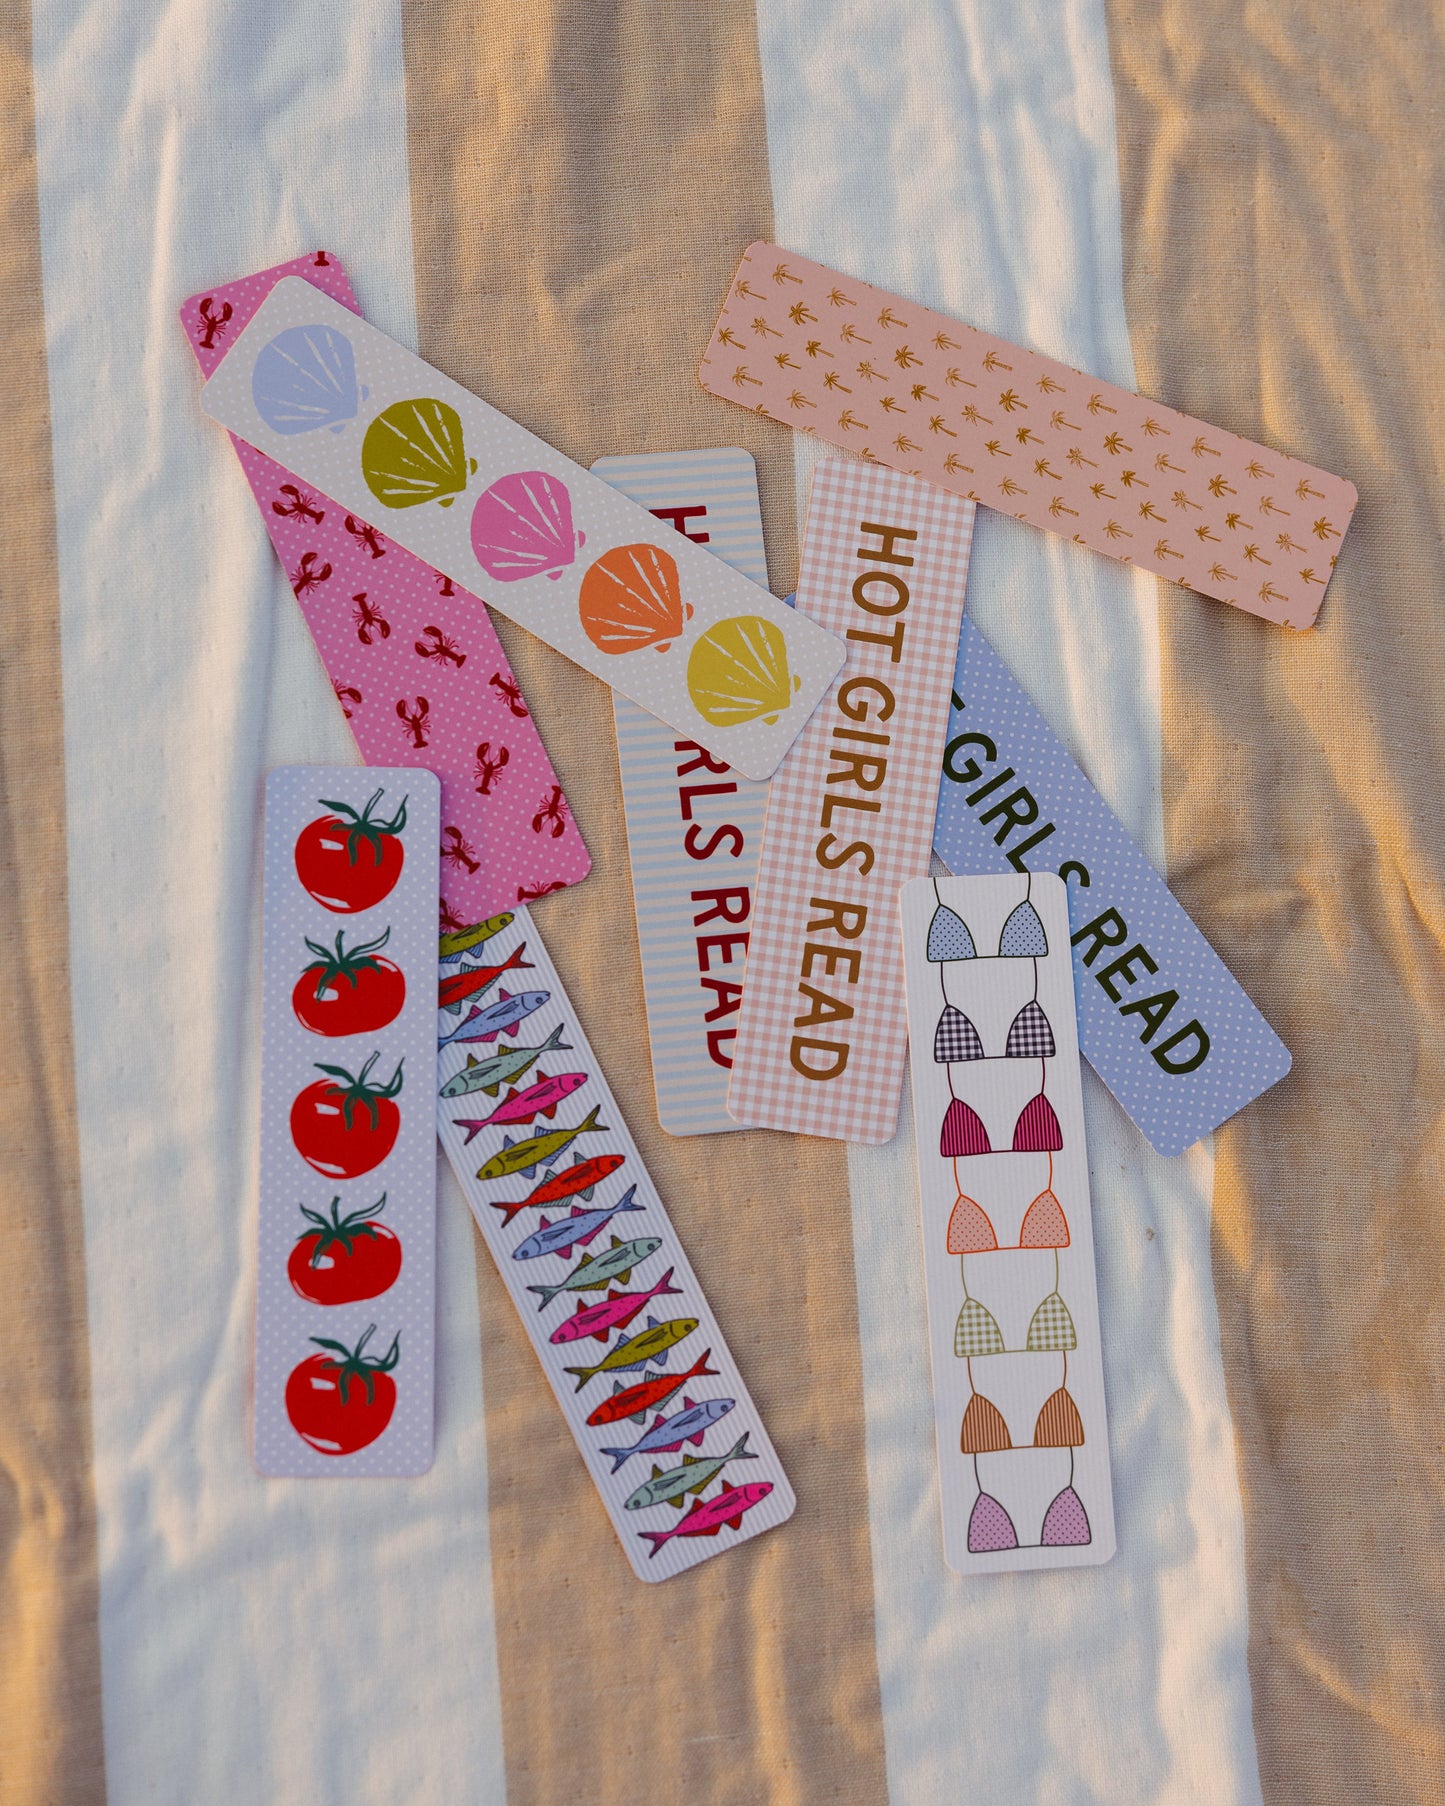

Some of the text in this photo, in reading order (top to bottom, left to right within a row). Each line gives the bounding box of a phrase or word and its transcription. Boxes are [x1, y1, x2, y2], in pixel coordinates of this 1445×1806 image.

[673, 740, 745, 861] RLS
[790, 522, 917, 1082] HOT GIRLS READ
[1070, 906, 1211, 1076] READ
